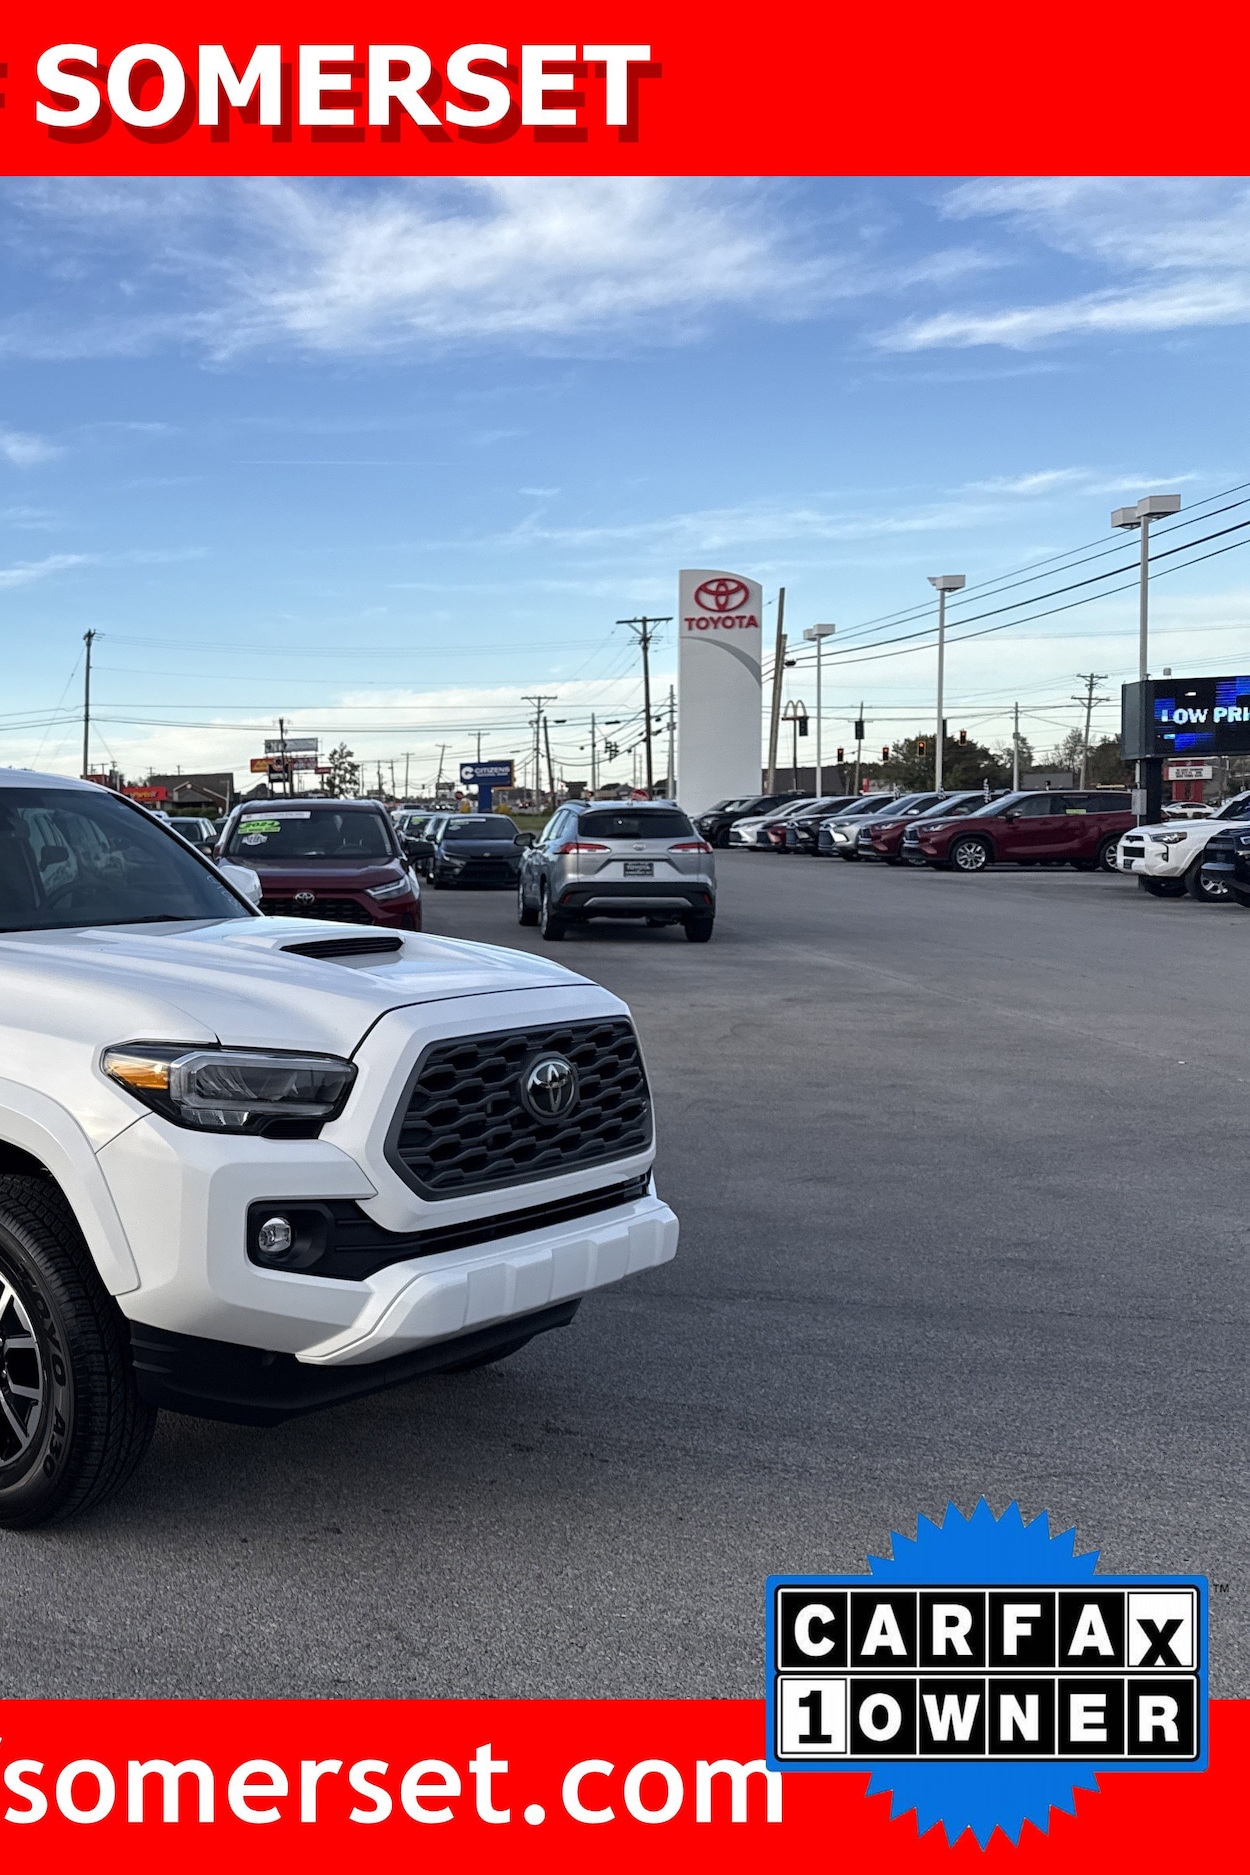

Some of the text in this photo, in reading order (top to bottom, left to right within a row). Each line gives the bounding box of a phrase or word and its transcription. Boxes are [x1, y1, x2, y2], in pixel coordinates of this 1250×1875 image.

[684, 615, 760, 631] TOYOTA
[1161, 706, 1250, 725] LOW PRI
